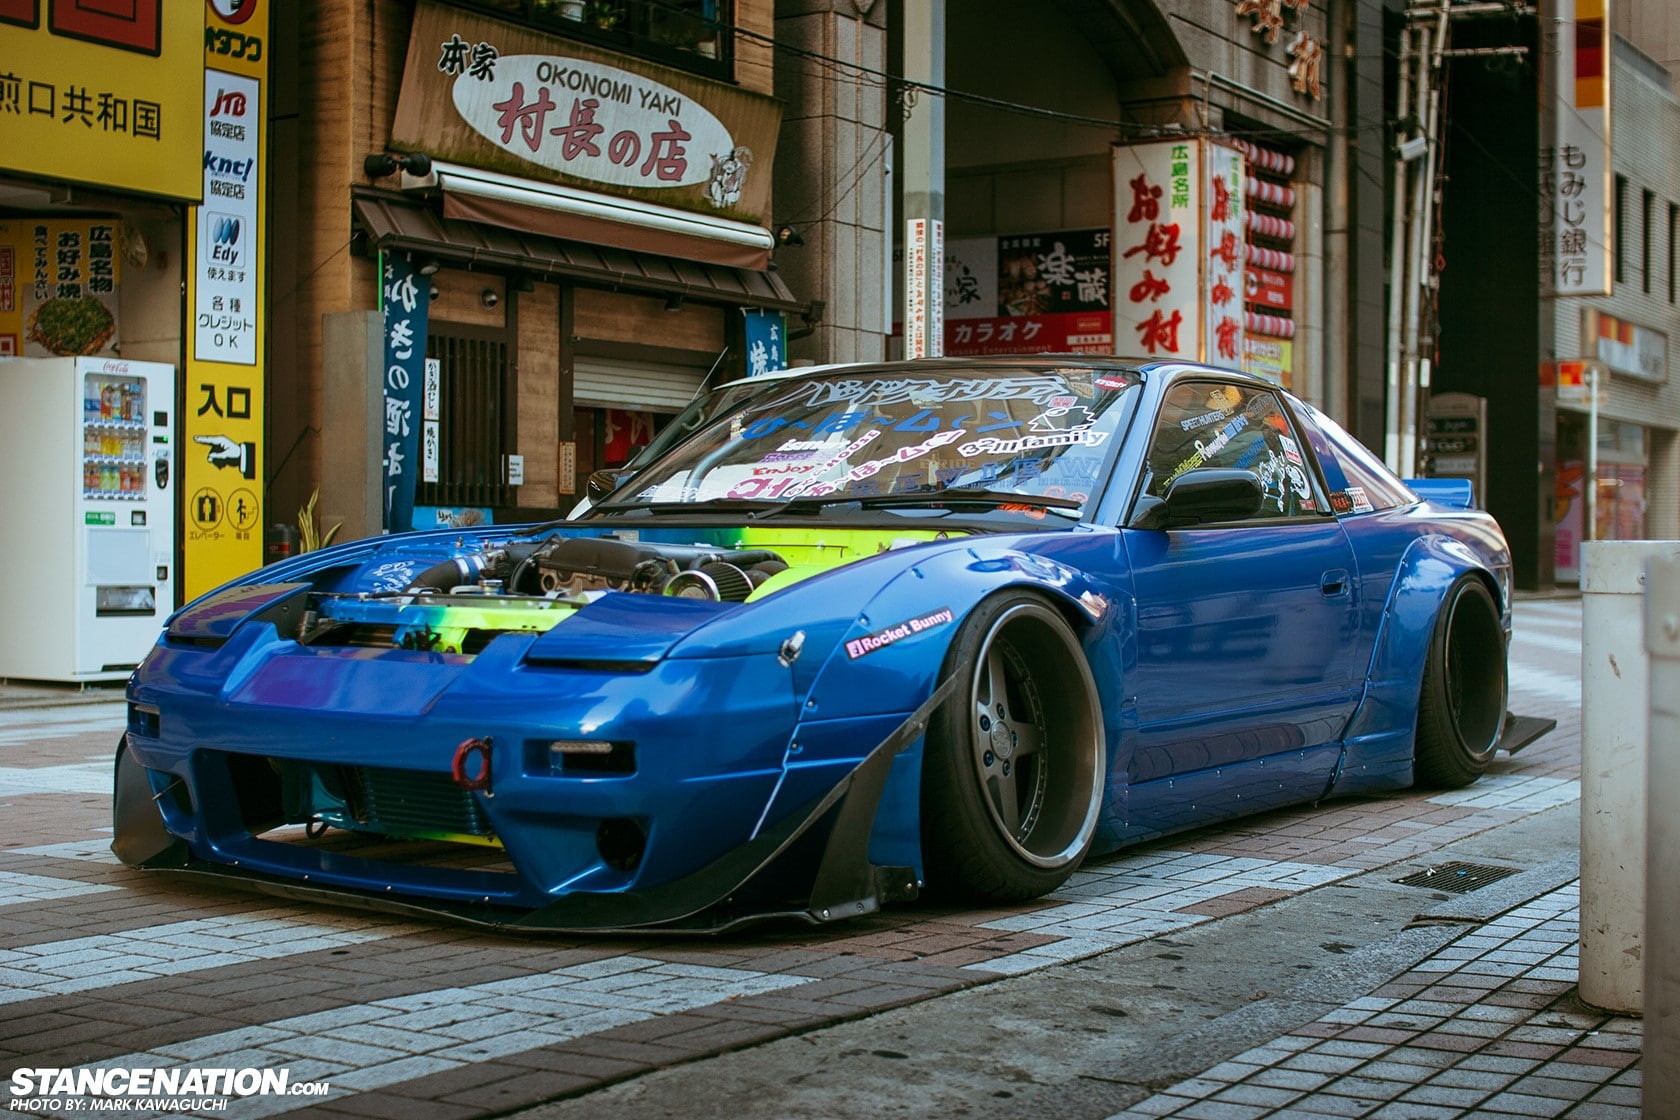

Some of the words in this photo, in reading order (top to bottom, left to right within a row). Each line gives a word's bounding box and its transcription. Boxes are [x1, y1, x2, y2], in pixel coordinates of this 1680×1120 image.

[438, 33, 498, 82] 本家
[209, 88, 248, 118] JTB
[536, 61, 633, 104] OKONOMI
[638, 87, 681, 118] YAKI
[210, 119, 245, 141] 協定店
[493, 82, 692, 182] 村長の店
[210, 179, 245, 200] 協定店
[1170, 145, 1189, 208] 広島名所
[1560, 143, 1587, 287] もみじ銀行
[56, 231, 82, 300] お好み焼
[88, 225, 114, 295] 広島名物
[212, 244, 239, 264] Edy
[1123, 173, 1183, 354] お好み村
[207, 268, 246, 283] 使えます
[212, 296, 242, 313] 各種
[199, 313, 253, 332] クレジット
[954, 321, 1043, 344] カラオケ
[213, 333, 239, 349] OK
[197, 384, 251, 419] 入口
[753, 463, 815, 477] Enjoy
[861, 623, 911, 651] Rocket
[909, 610, 953, 633] Bunny
